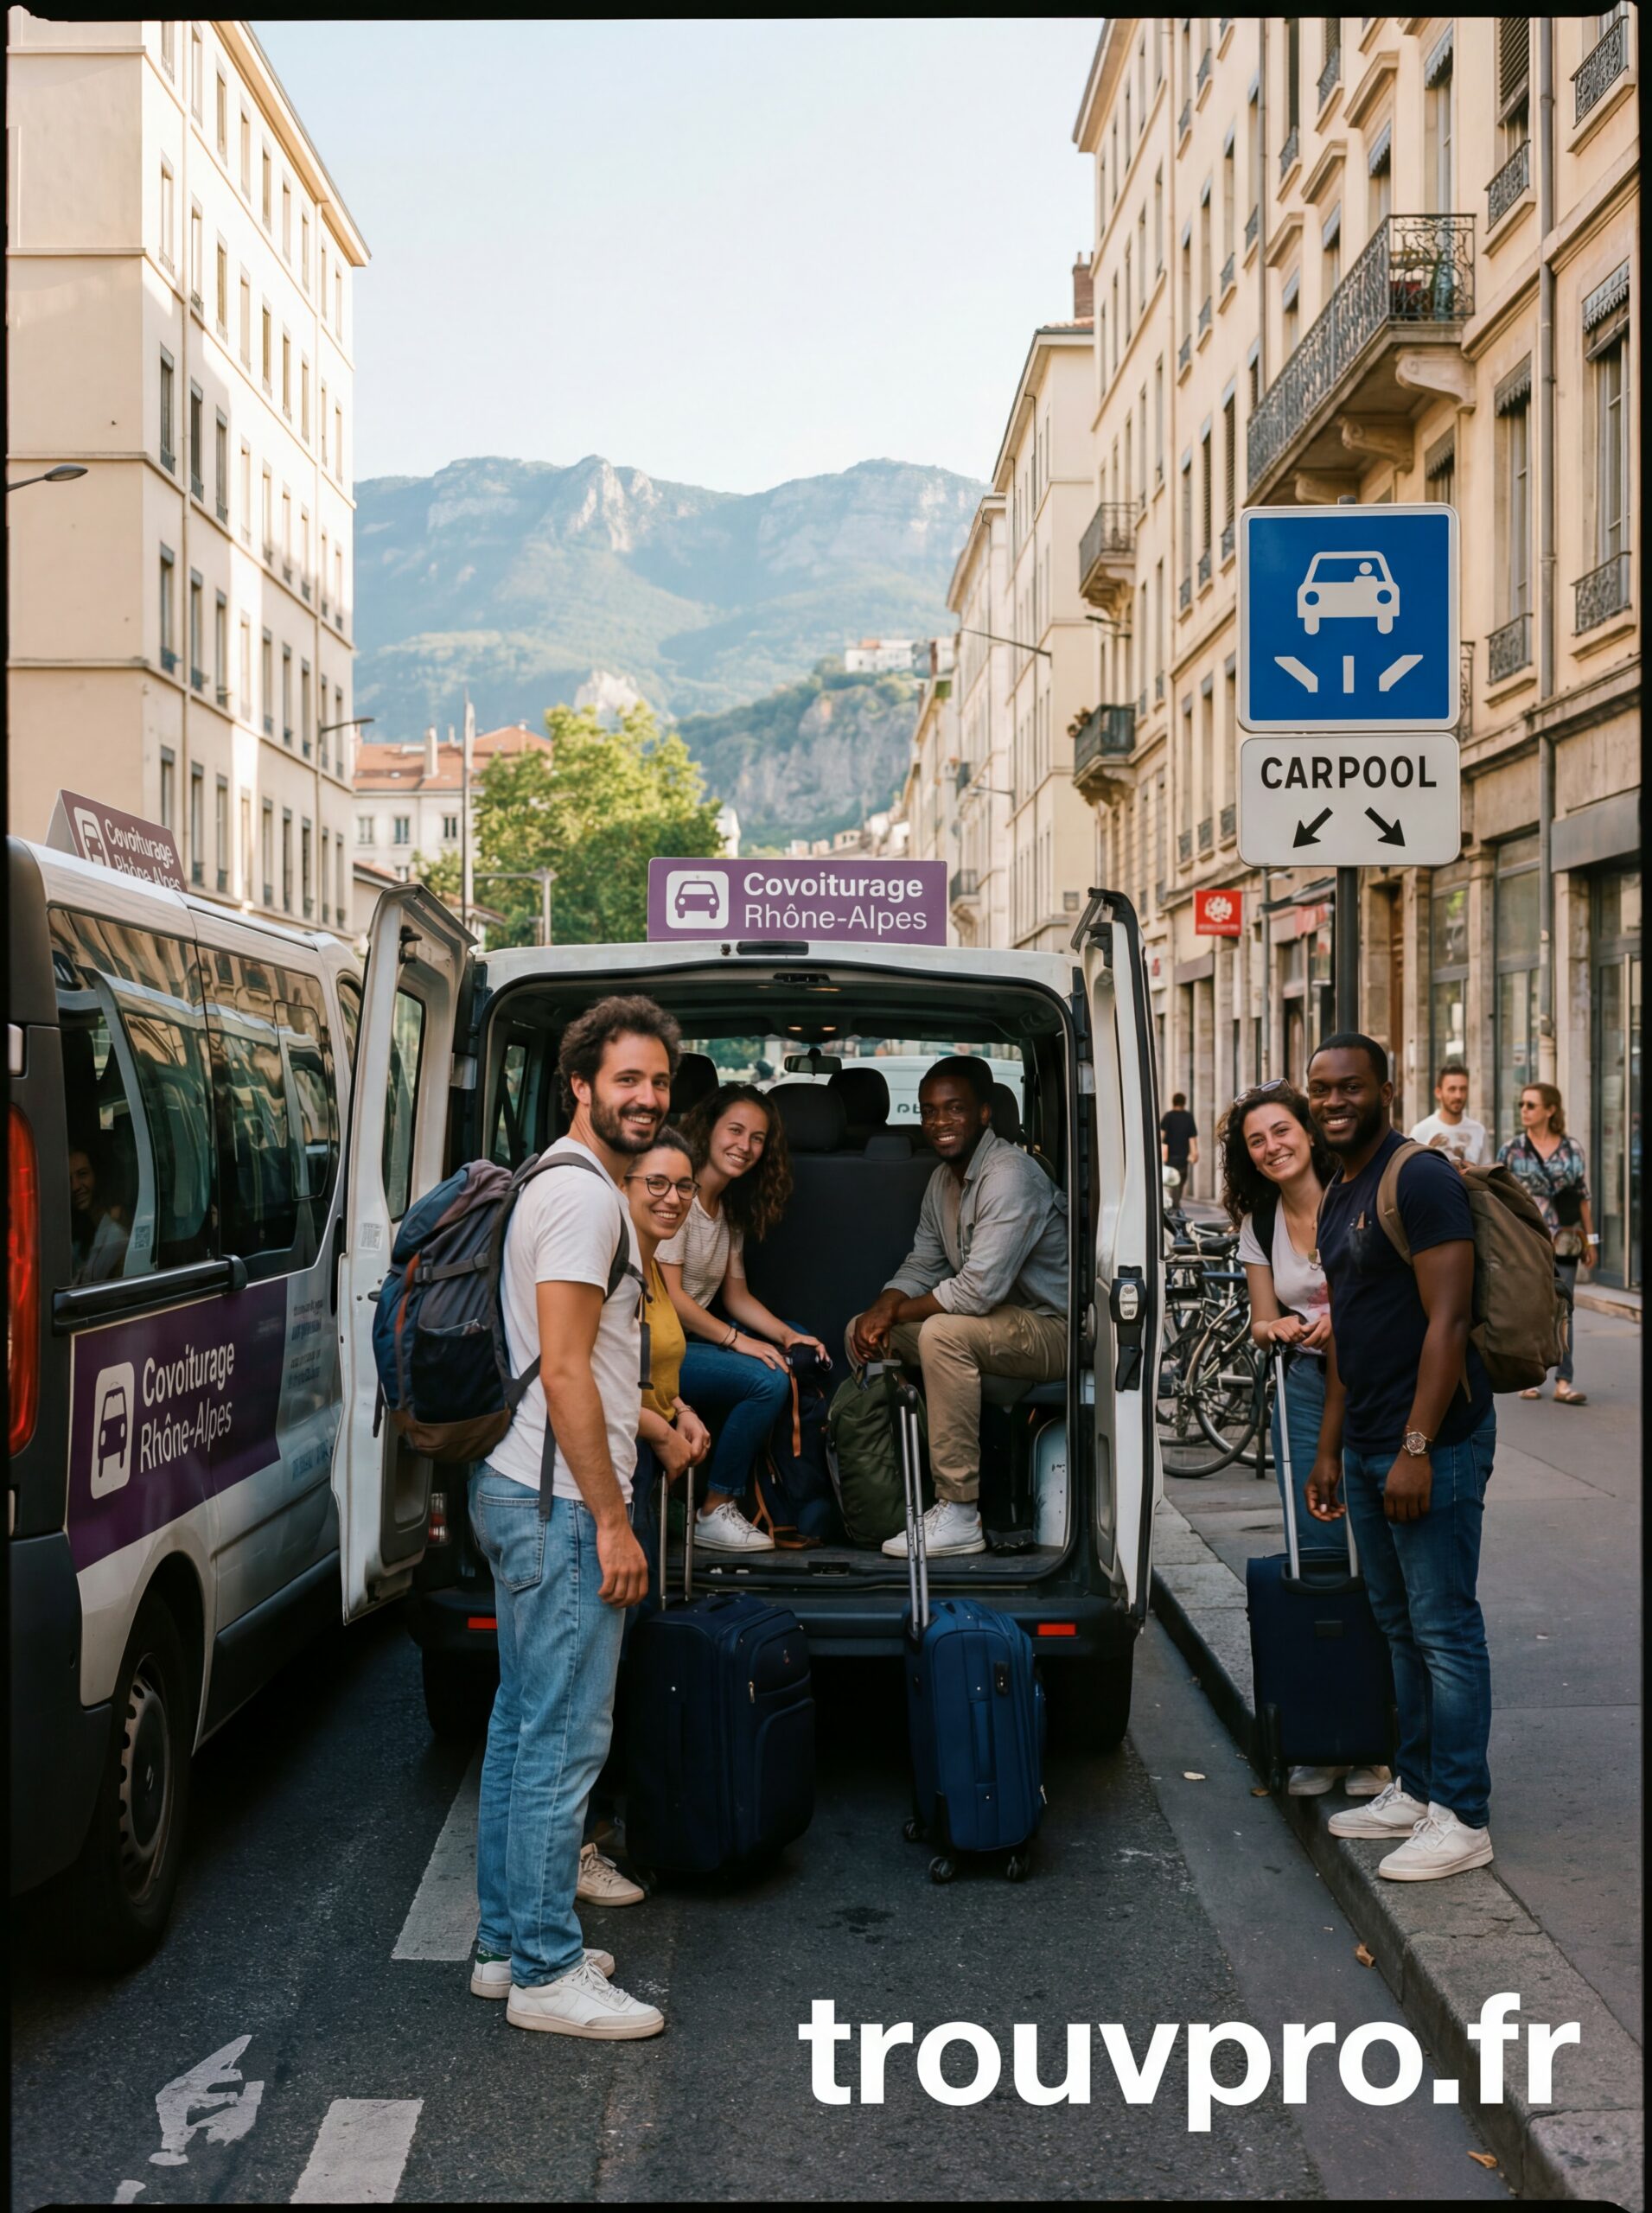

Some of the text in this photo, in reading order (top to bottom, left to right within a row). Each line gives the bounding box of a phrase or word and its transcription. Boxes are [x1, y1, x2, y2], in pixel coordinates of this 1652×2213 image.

[1260, 755, 1437, 790] CARPOOL
[105, 819, 174, 870] Covoiturage
[743, 872, 923, 902] Covoiturage
[745, 904, 928, 935] Rhône-Alpes
[143, 1342, 235, 1407] Covoiturage
[140, 1398, 233, 1473] Rhône-Alpes
